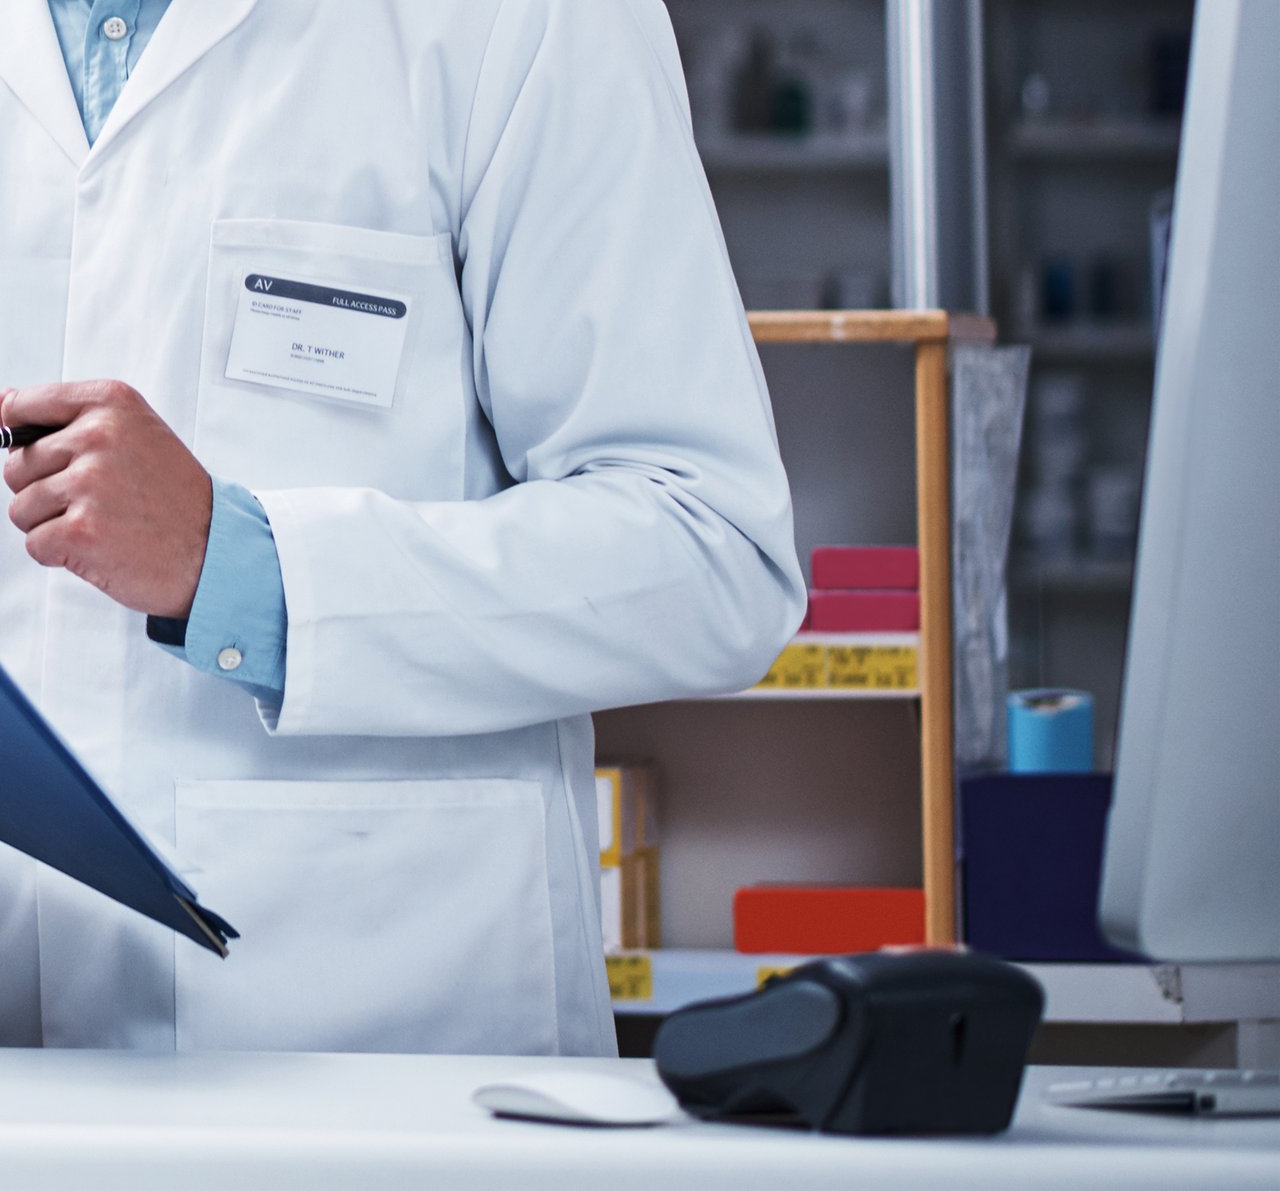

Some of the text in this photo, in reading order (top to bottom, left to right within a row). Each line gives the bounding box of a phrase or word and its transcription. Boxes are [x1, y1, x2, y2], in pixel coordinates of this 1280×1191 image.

[254, 277, 273, 291] AV
[332, 296, 397, 316] FULL ACCESS PASS
[291, 342, 305, 352] DR.
[307, 345, 312, 353] T
[314, 346, 345, 359] WITHER
